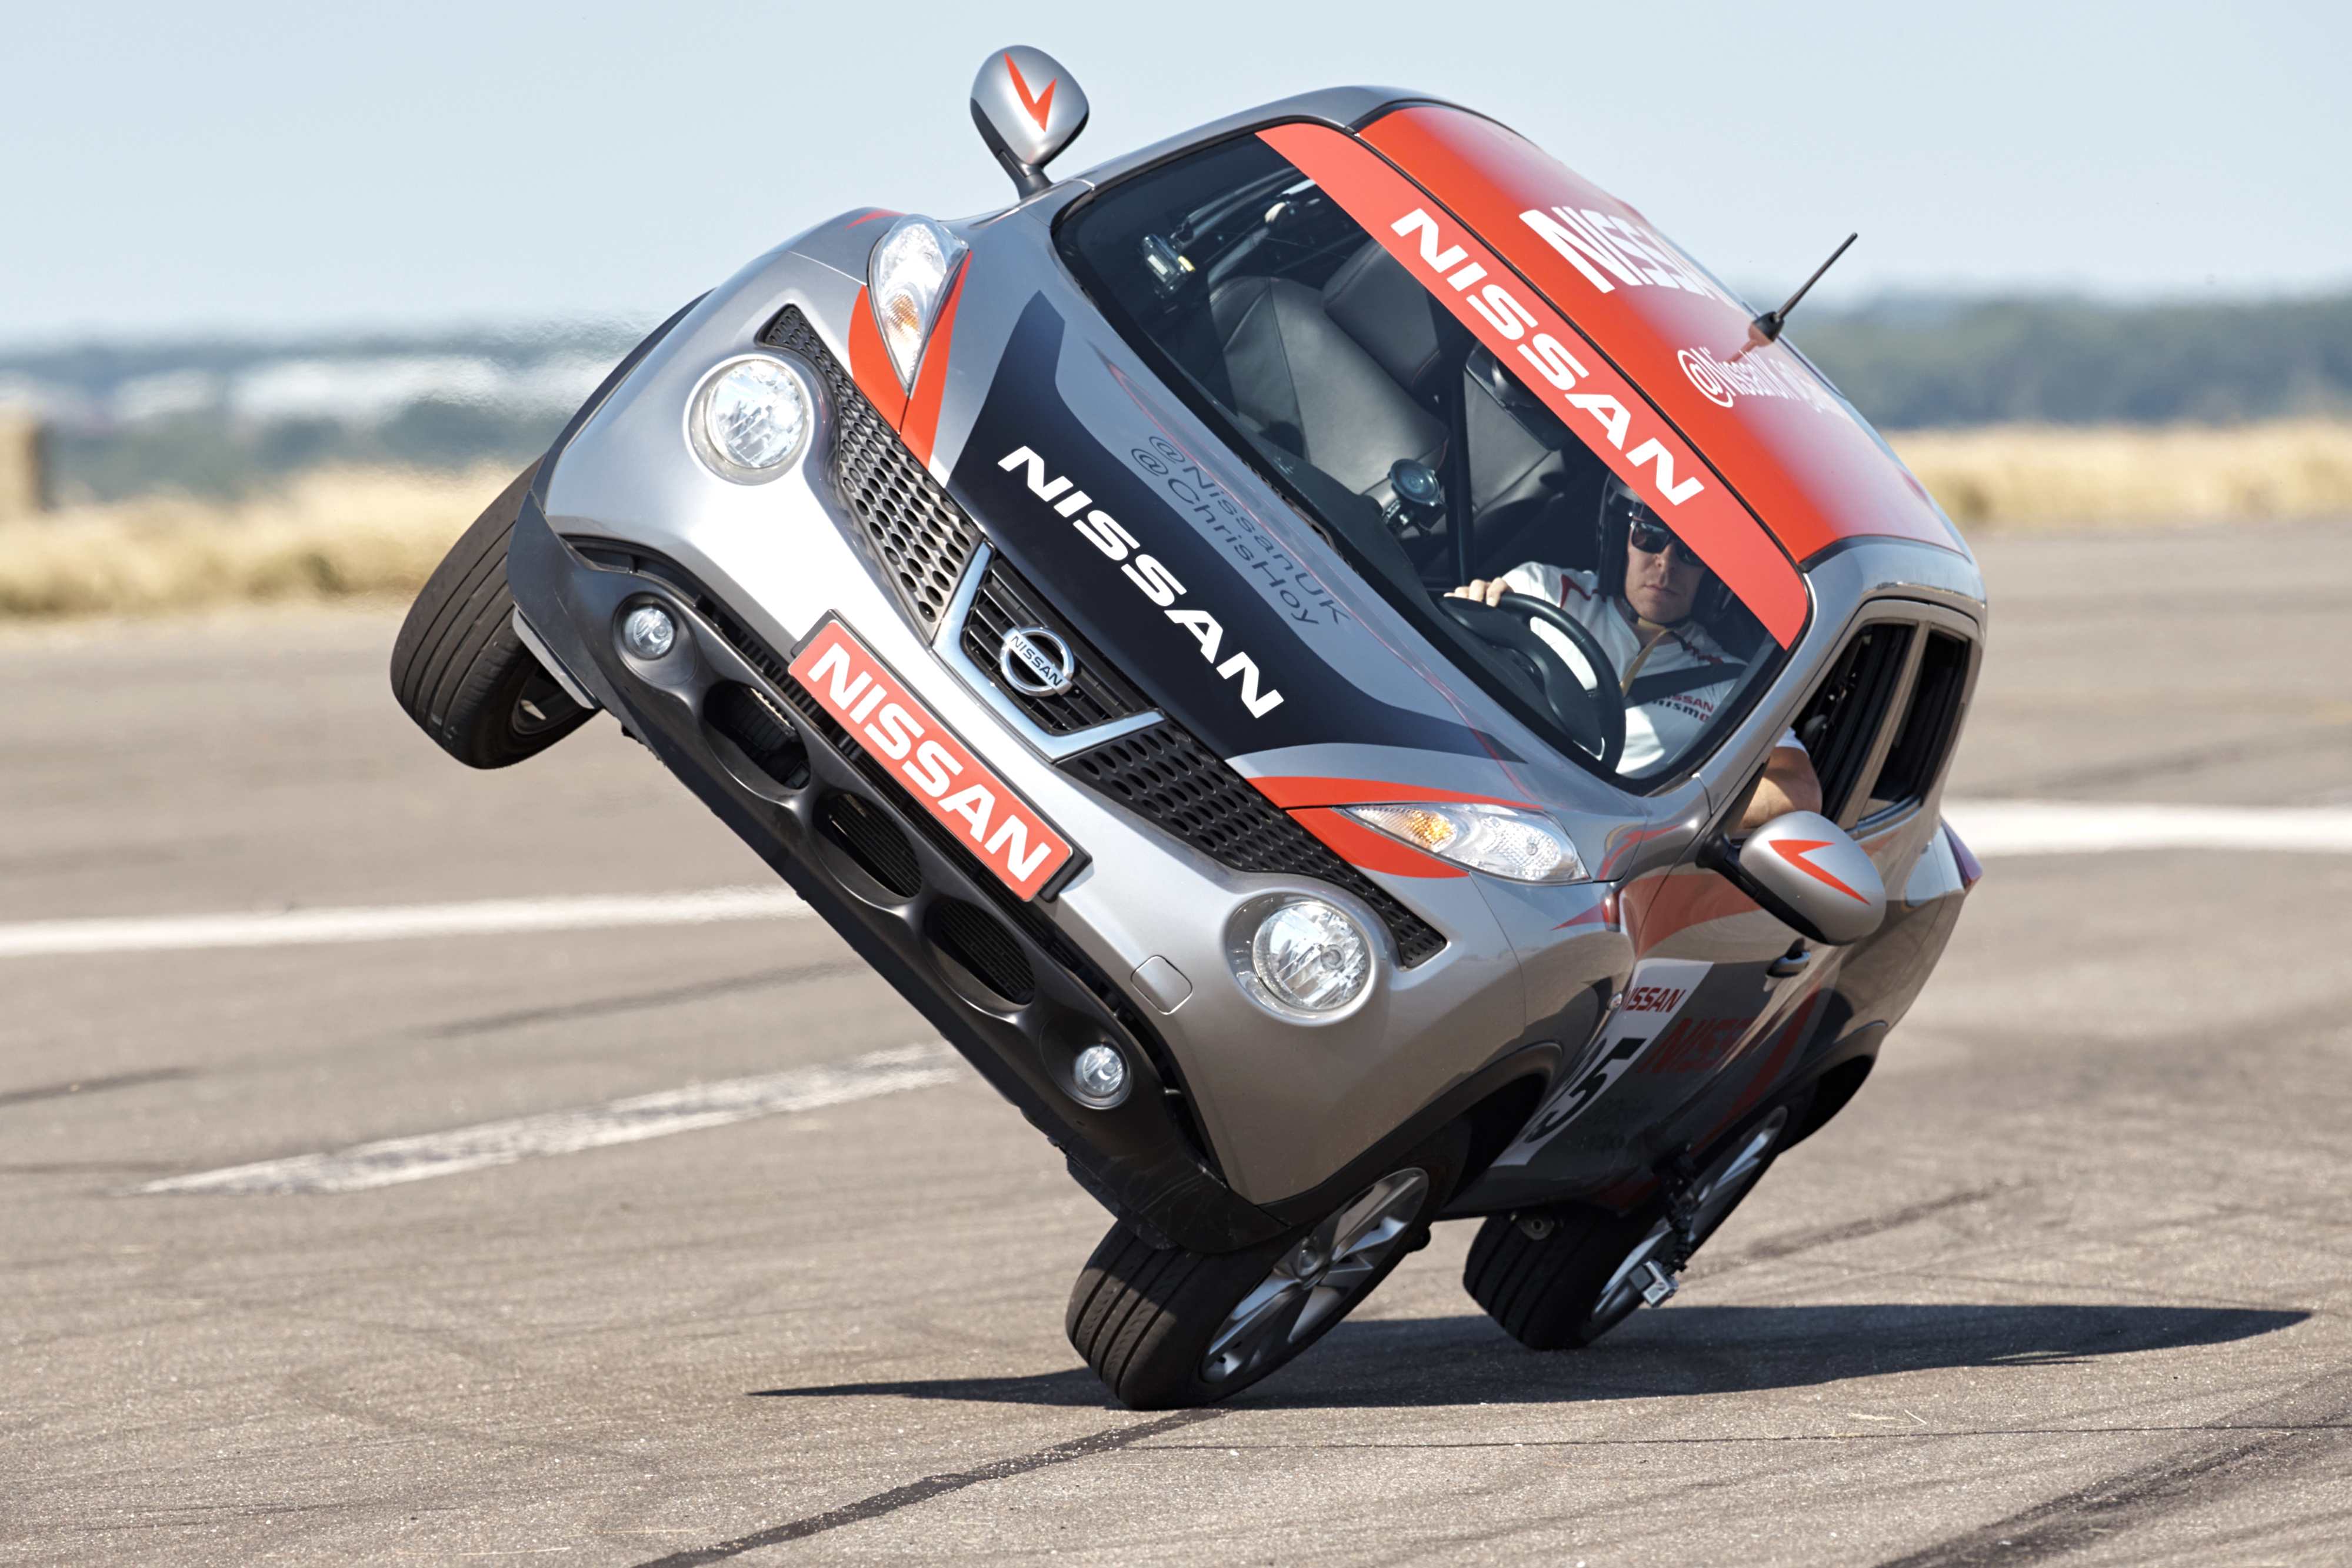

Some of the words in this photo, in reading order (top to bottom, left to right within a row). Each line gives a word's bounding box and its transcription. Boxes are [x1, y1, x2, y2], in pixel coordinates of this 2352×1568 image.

[1391, 208, 1705, 506] NISSAN
[997, 445, 1284, 719] NISSAN
[1130, 448, 1320, 627] @ChrisHoy
[1148, 436, 1352, 625] @NissanUK
[807, 642, 1052, 882] NISSAN
[1010, 635, 1063, 688] NISSAN
